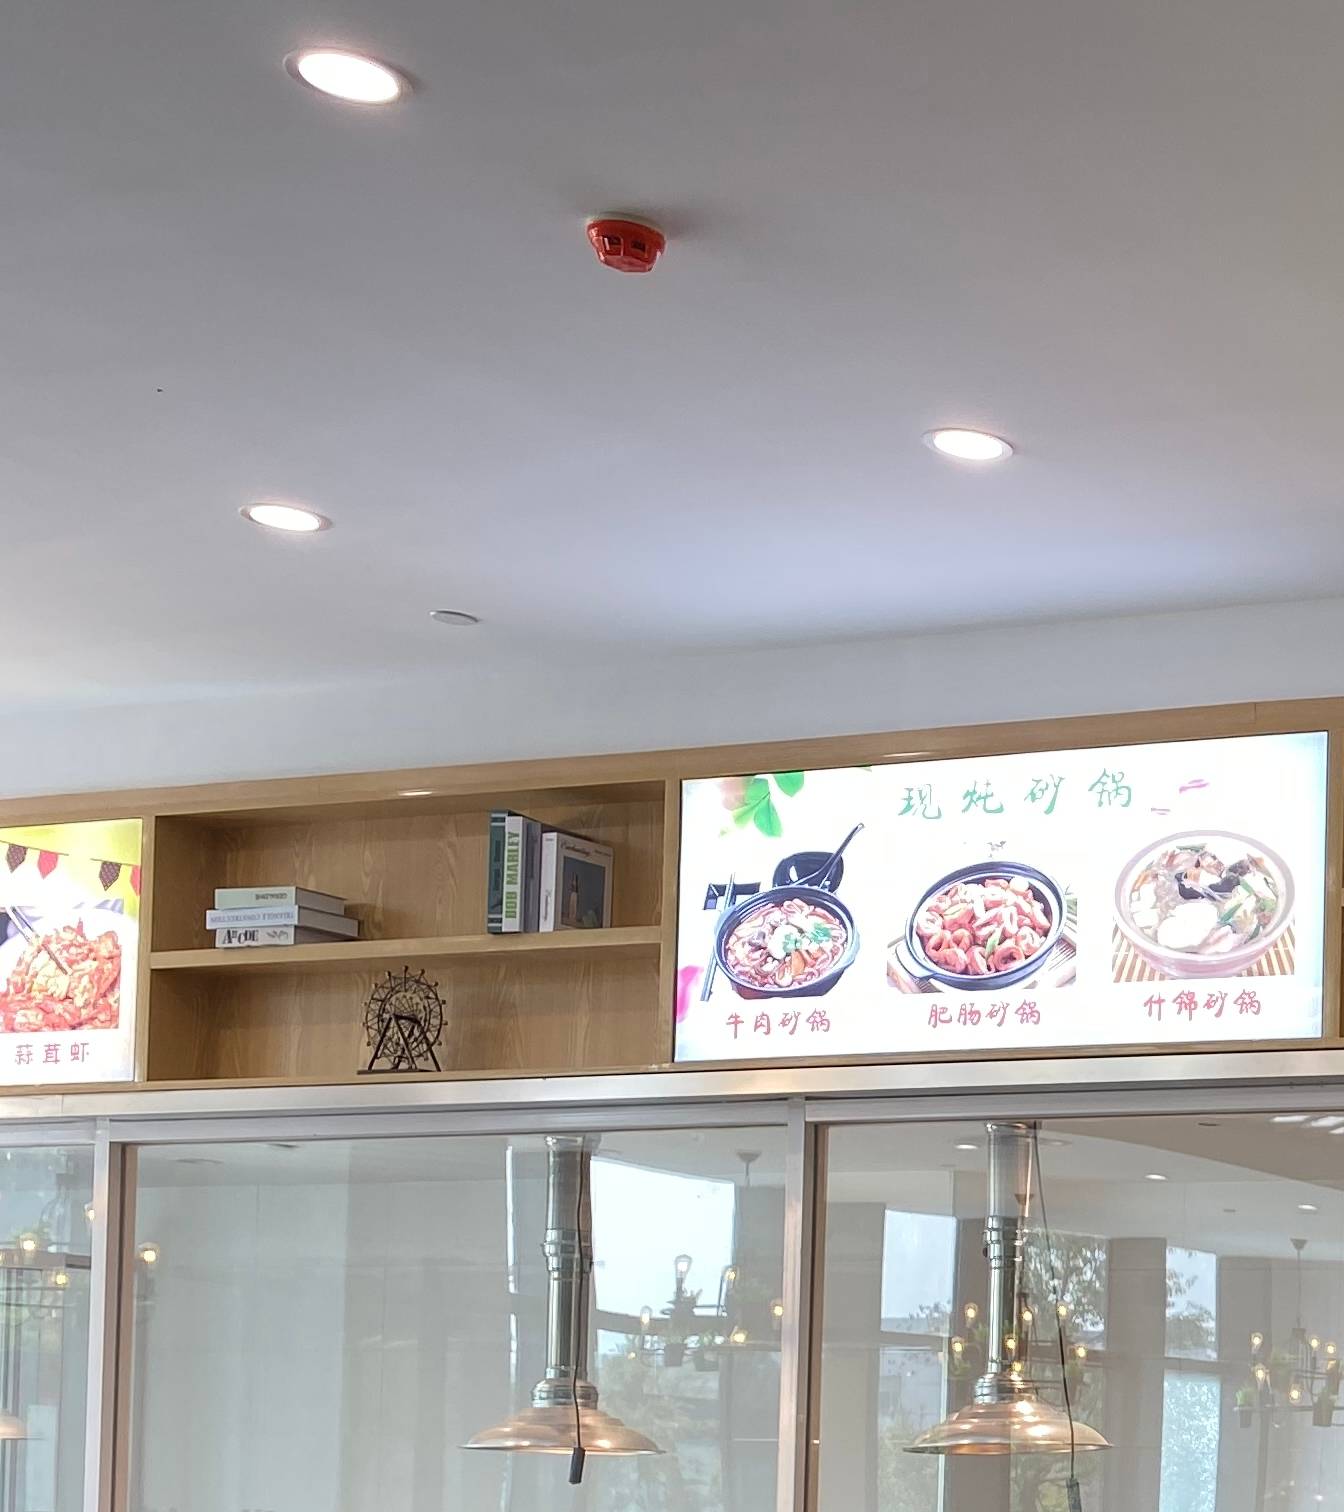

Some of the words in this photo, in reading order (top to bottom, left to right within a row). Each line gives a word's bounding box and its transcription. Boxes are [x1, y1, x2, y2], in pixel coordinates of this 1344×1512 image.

[898, 768, 1133, 820] 现炖砂锅
[506, 831, 519, 885] MARLEY
[927, 998, 1042, 1028] 肥肠砂锅
[1142, 988, 1263, 1023] 什锦砂锅
[725, 1007, 831, 1039] 牛肉砂锅
[15, 1042, 90, 1065] 蒜茸虾
